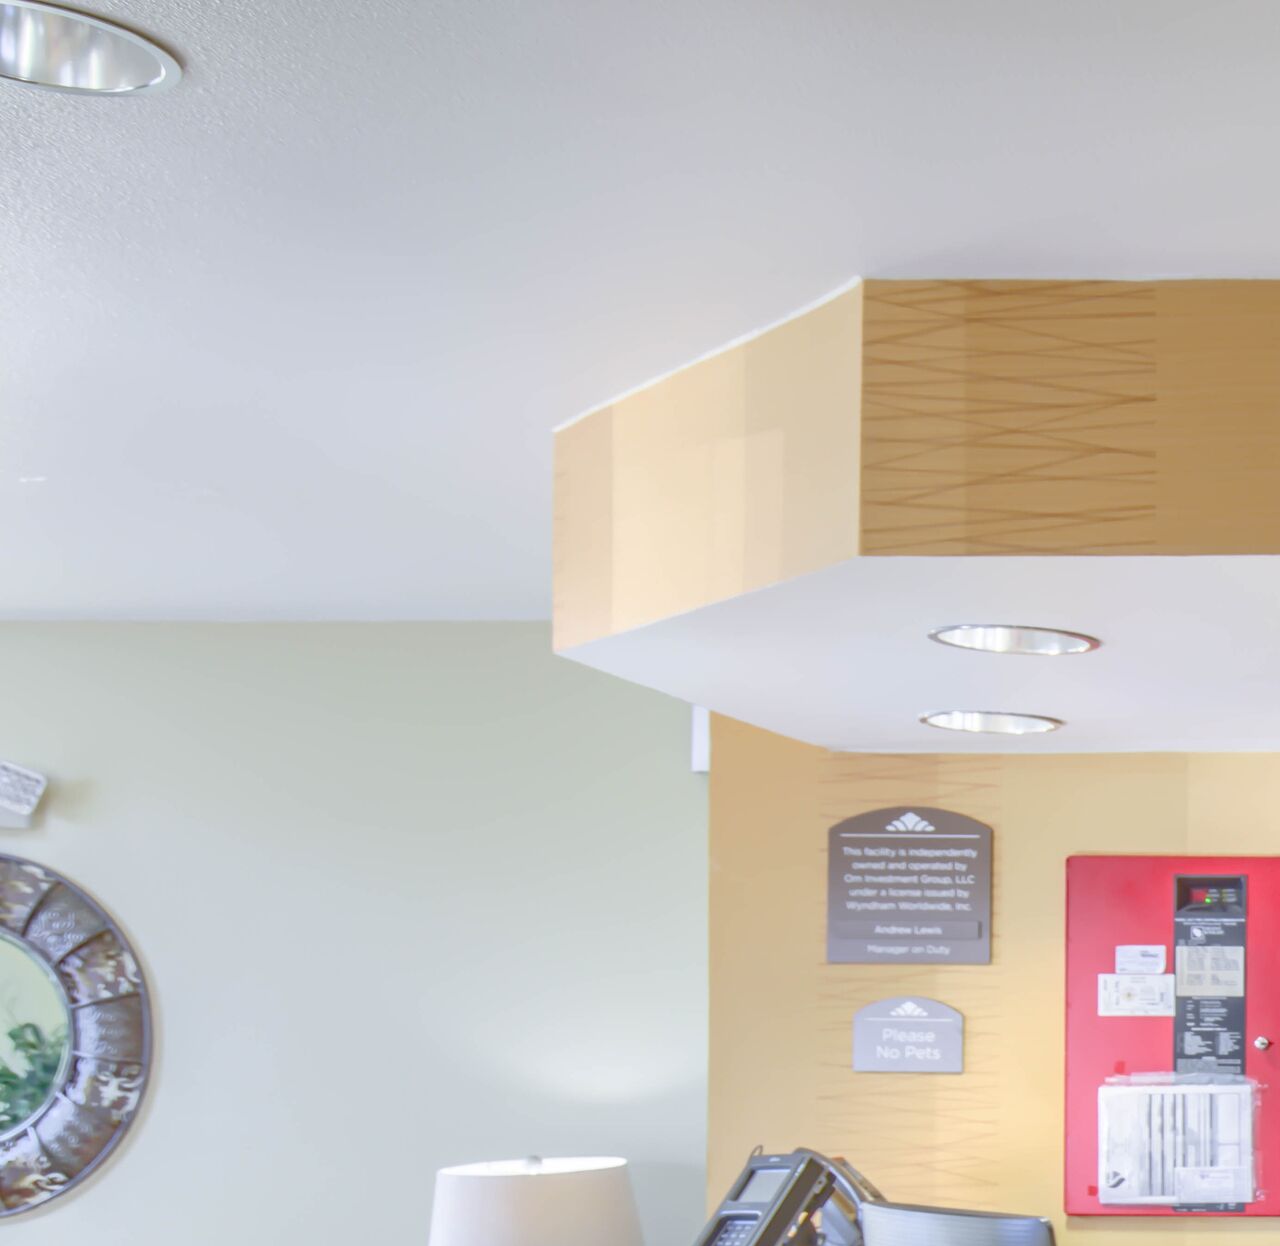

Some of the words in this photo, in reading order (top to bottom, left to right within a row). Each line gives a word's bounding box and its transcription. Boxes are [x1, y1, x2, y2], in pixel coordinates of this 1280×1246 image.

[842, 846, 862, 857] This
[864, 847, 897, 859] facility
[908, 848, 978, 859] independently
[852, 861, 886, 870] owned
[887, 861, 907, 870] and
[908, 861, 953, 872] operated
[954, 861, 968, 873] by
[864, 874, 919, 884] Investment
[955, 875, 976, 884] LLC
[848, 888, 878, 897] under
[888, 888, 922, 898] license
[956, 888, 970, 900] by
[845, 901, 896, 912] Wyndham
[874, 925, 912, 935] Andrew
[866, 944, 909, 956] Manager
[911, 946, 925, 955] on
[926, 945, 951, 956] Duty
[882, 1028, 936, 1043] Please
[875, 1045, 900, 1060] No
[904, 1046, 942, 1061] Pets
